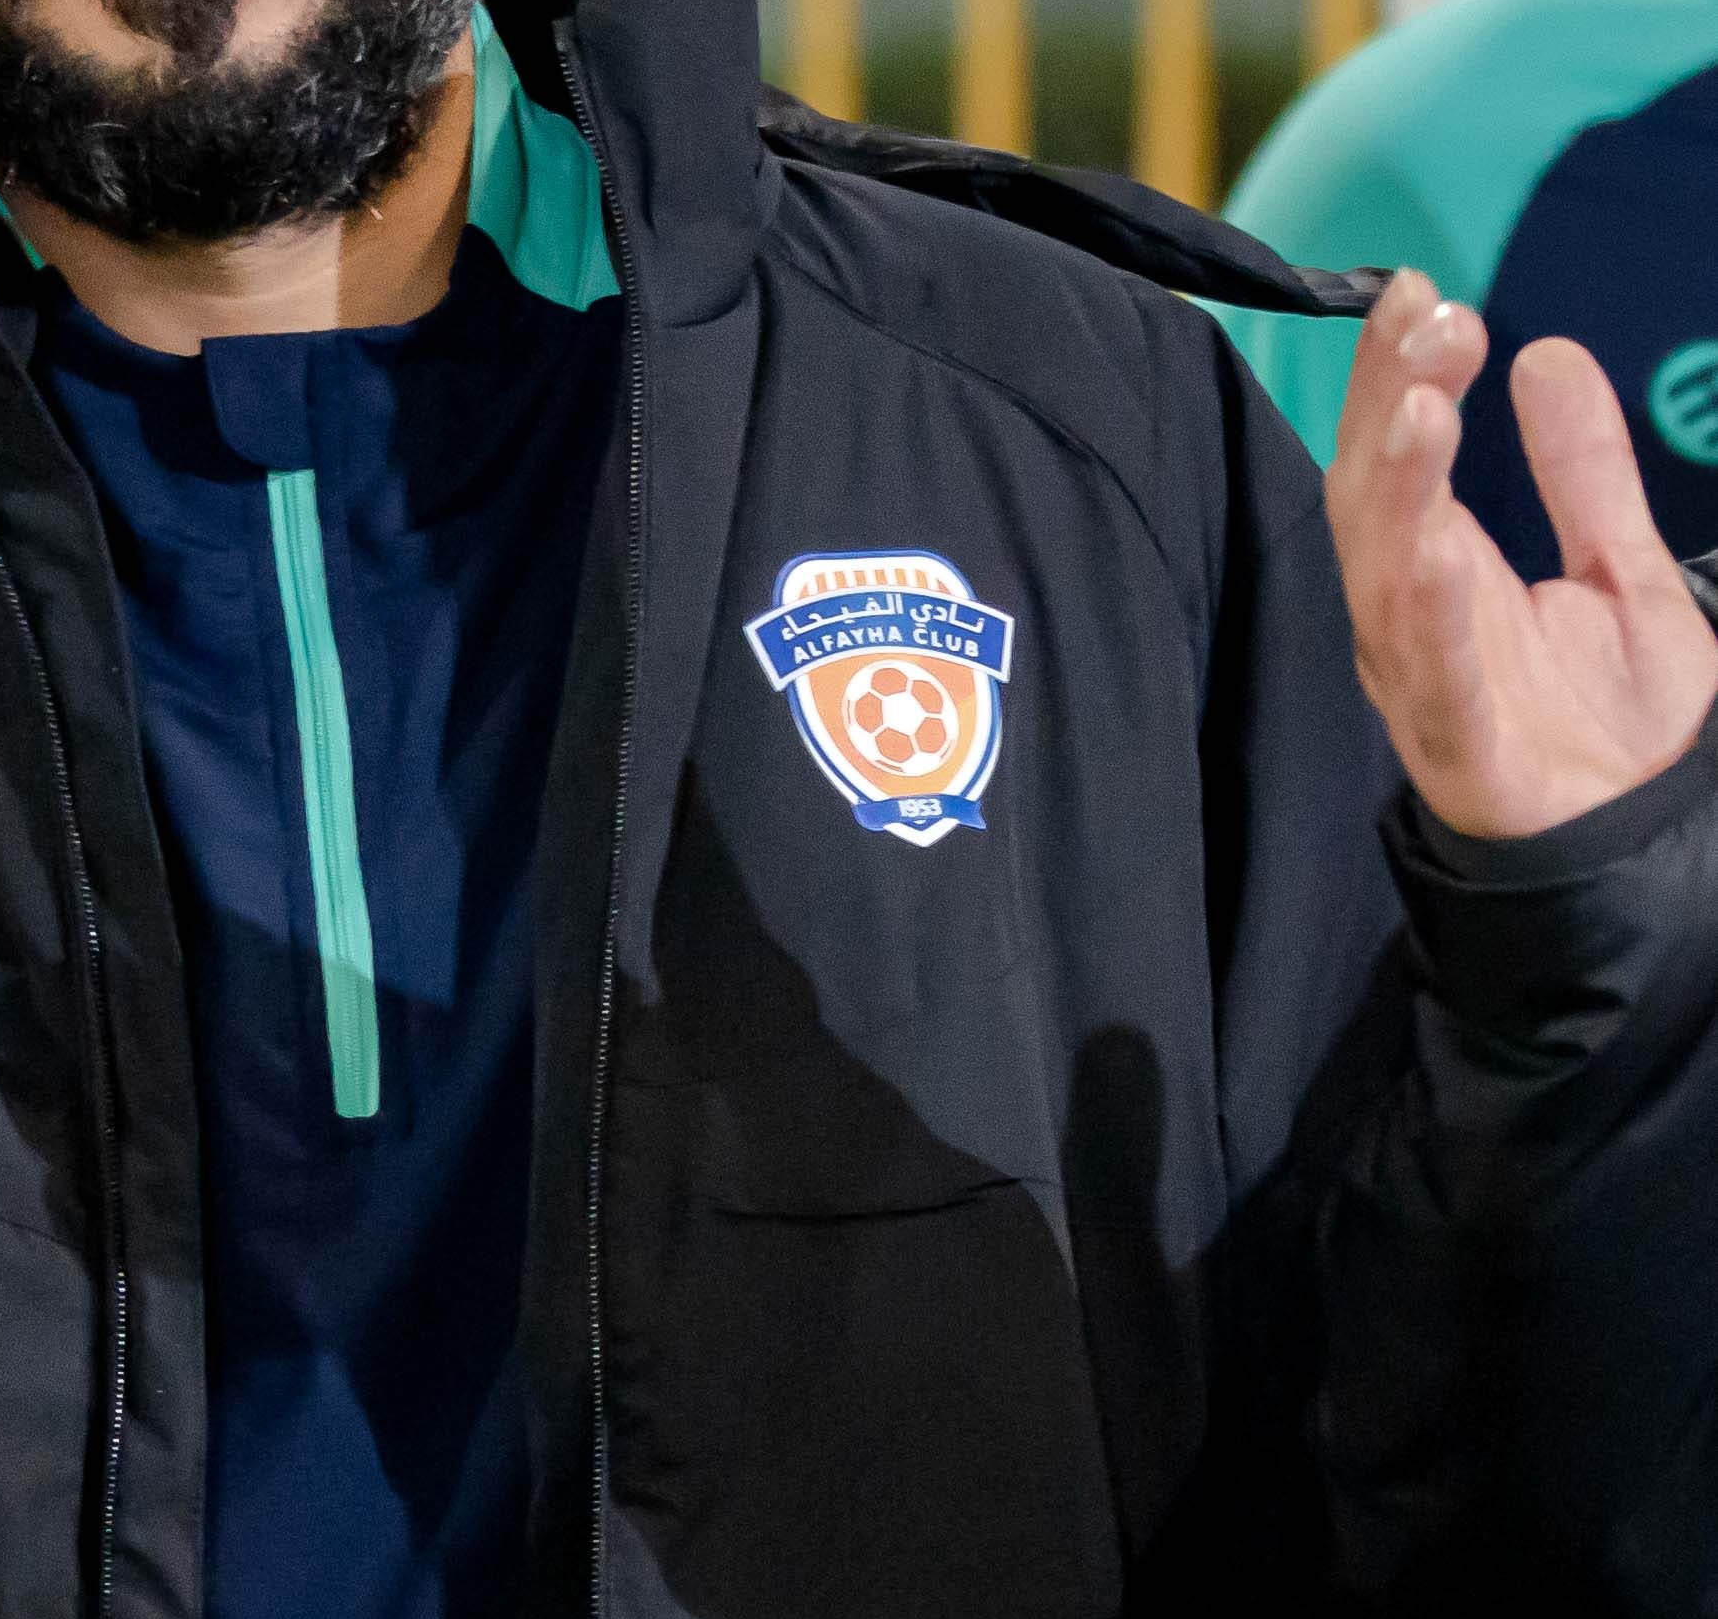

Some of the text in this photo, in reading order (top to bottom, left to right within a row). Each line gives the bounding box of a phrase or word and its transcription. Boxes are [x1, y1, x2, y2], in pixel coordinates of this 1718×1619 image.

[782, 593, 985, 641] نادي الفيحاء
[794, 626, 979, 664] ALFAYHA CLUB
